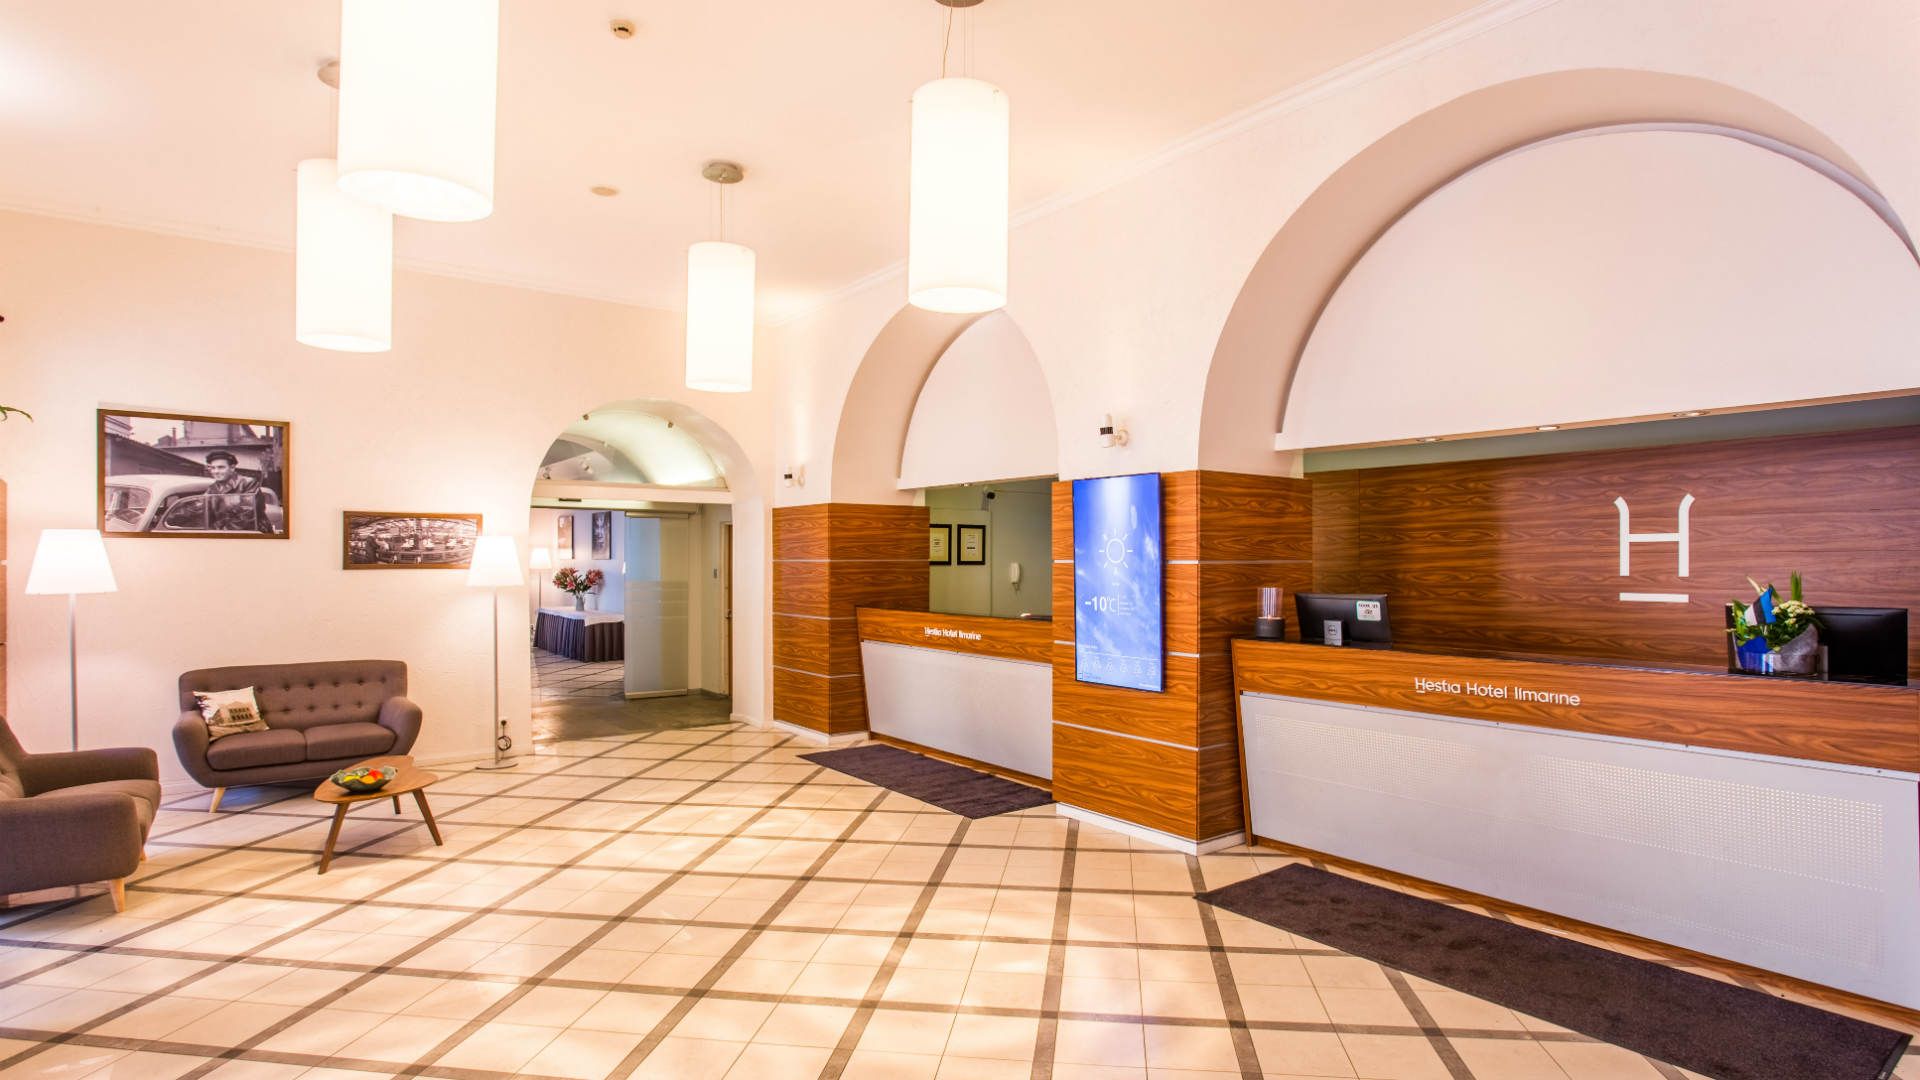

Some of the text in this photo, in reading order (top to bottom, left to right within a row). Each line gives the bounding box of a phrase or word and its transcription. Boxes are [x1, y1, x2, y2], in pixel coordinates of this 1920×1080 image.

[1614, 493, 1695, 577] H
[924, 627, 941, 637] Hestia
[942, 629, 958, 638] Hotel
[1414, 677, 1581, 706] Hestia Hotel Ilmarine
